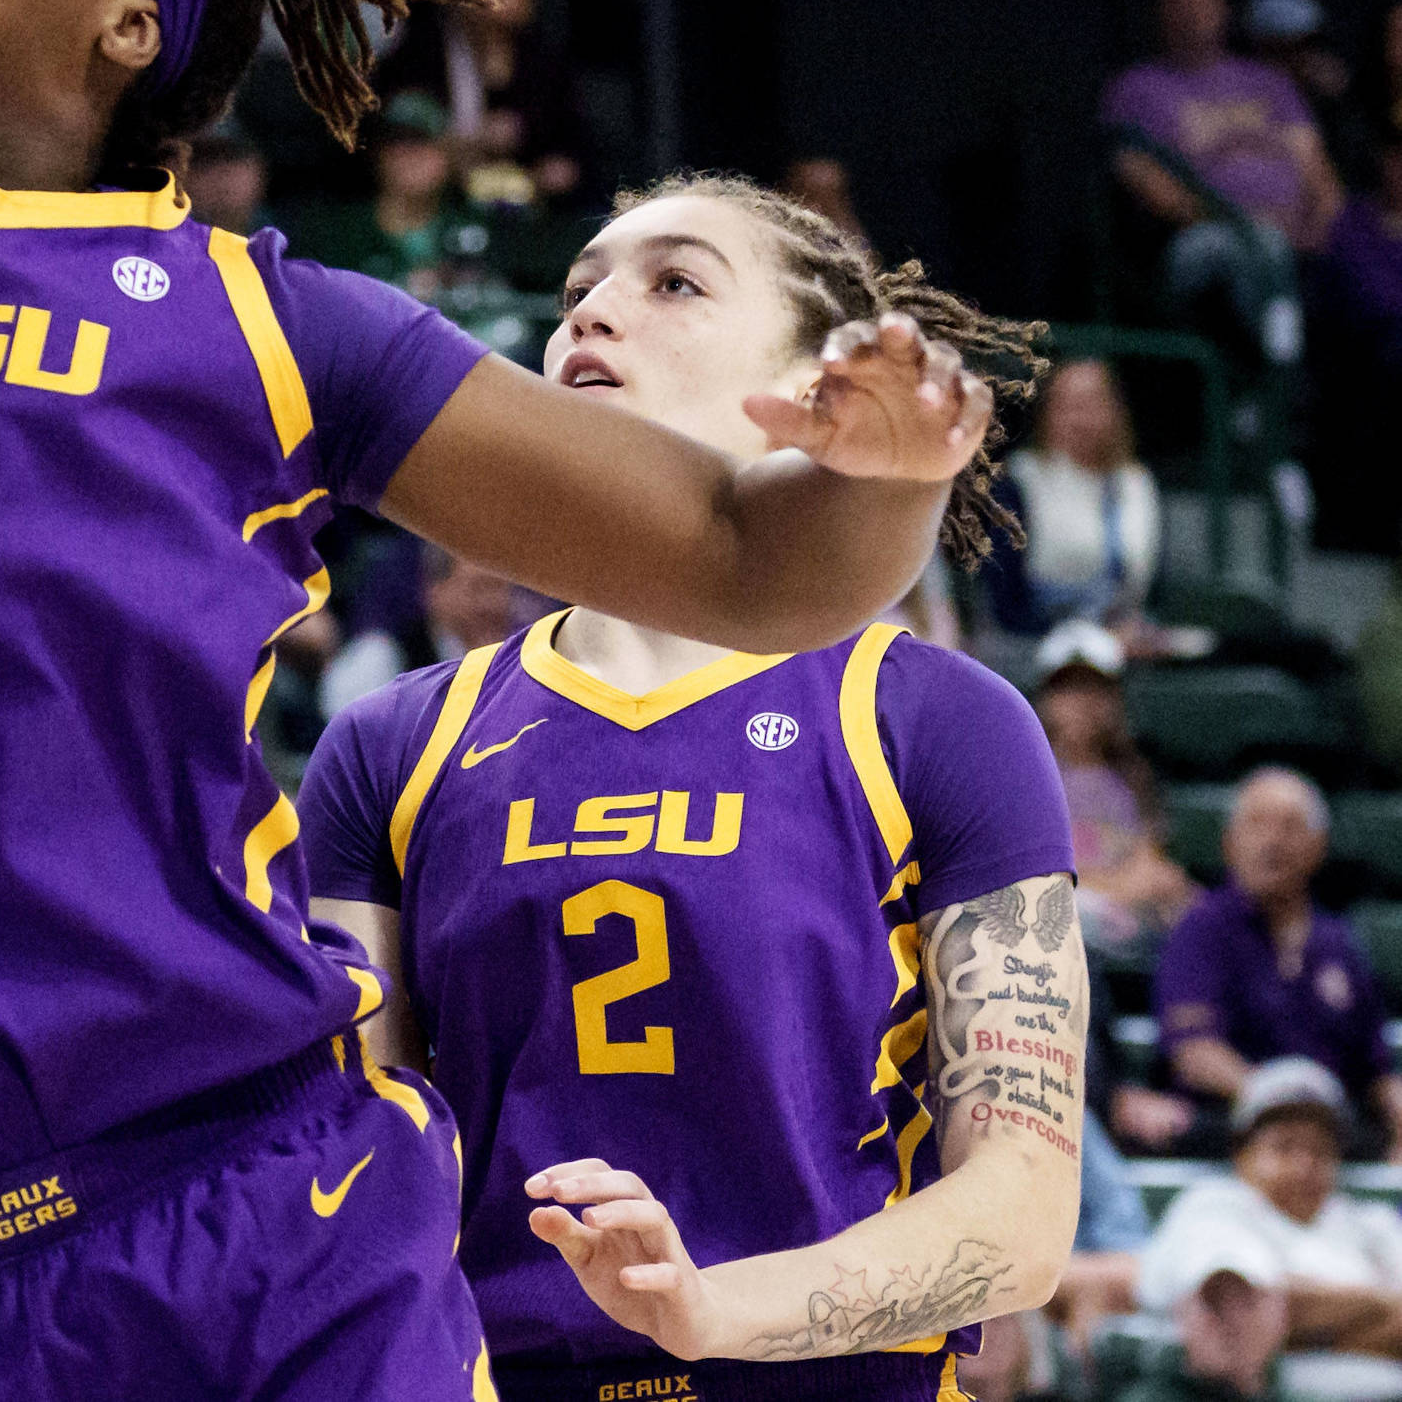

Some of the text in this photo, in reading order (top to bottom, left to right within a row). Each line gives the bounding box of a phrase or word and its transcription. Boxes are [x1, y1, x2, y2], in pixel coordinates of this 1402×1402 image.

[115, 258, 168, 298] SEC
[750, 714, 796, 748] SEC
[502, 790, 745, 866] LSU
[562, 878, 676, 1075] 2
[987, 982, 1014, 1000] and
[971, 1102, 1077, 1159] Overcome
[598, 1374, 692, 1401] GEAUX
